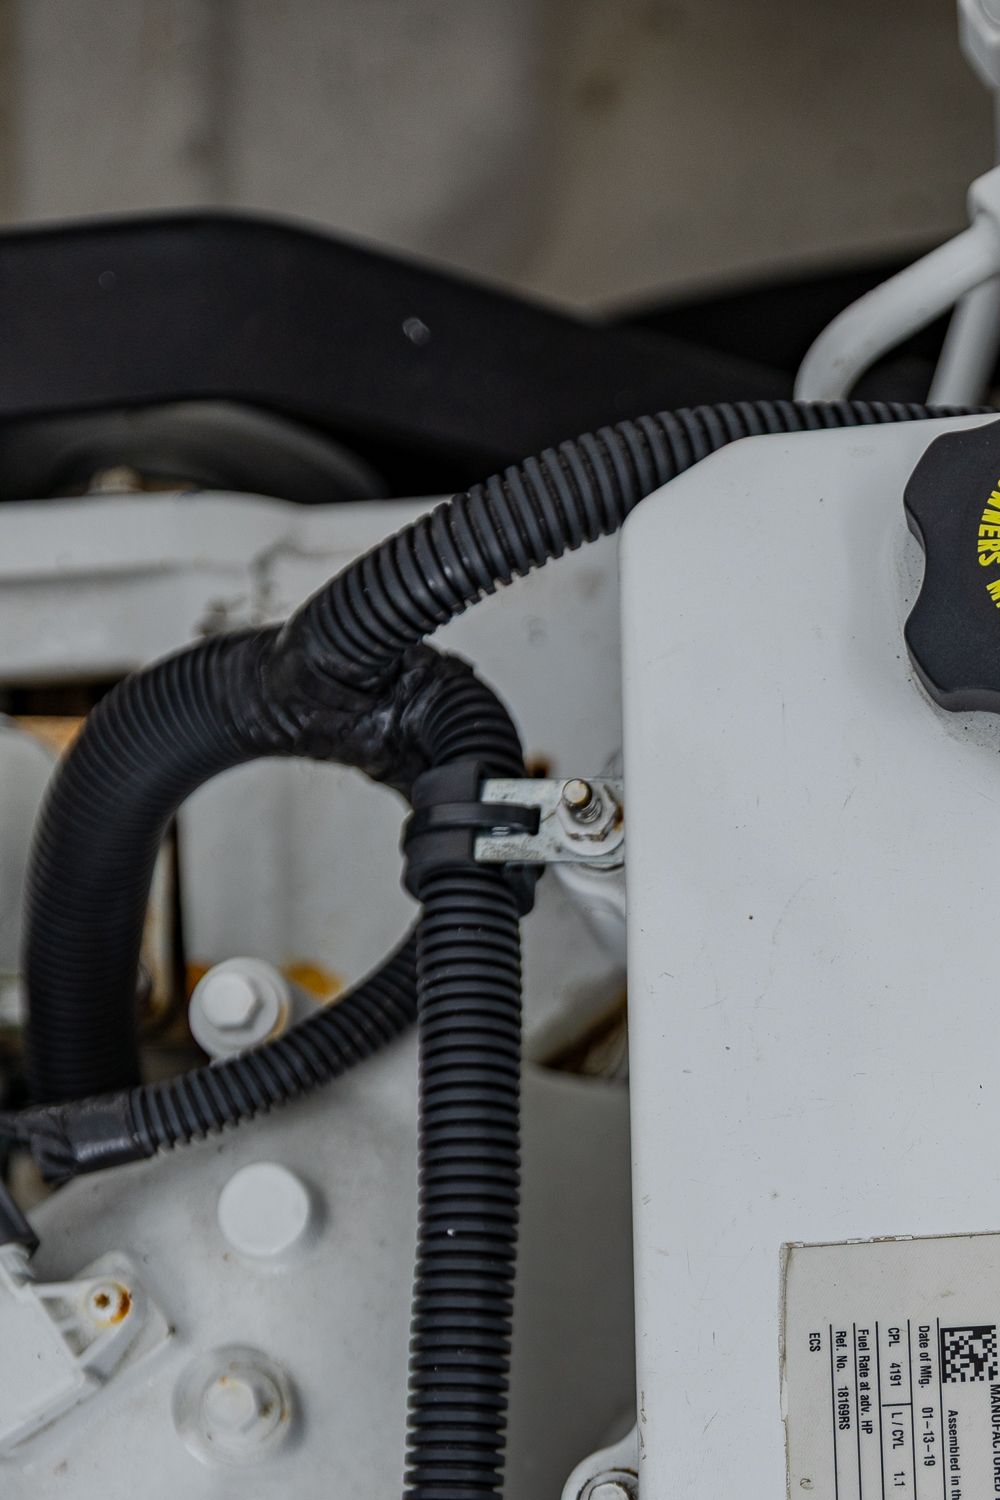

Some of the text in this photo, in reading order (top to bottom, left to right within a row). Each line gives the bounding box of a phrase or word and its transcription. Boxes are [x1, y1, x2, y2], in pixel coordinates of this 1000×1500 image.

[808, 1332, 820, 1352] ECS
[857, 1329, 869, 1350] Fuel
[918, 1325, 930, 1348] Date
[858, 1355, 870, 1377] Rate
[887, 1327, 901, 1386] CPL 4191
[919, 1352, 931, 1362] of
[835, 1330, 850, 1430] Ref. No. 18169RS
[859, 1381, 870, 1391] at
[917, 1365, 932, 1388] Mfg.
[860, 1394, 871, 1415] adv.
[860, 1420, 872, 1434] HP
[891, 1429, 904, 1449] CYL
[947, 1409, 960, 1470] Assembled
[893, 1471, 905, 1486] 1.1
[950, 1475, 960, 1485] in
